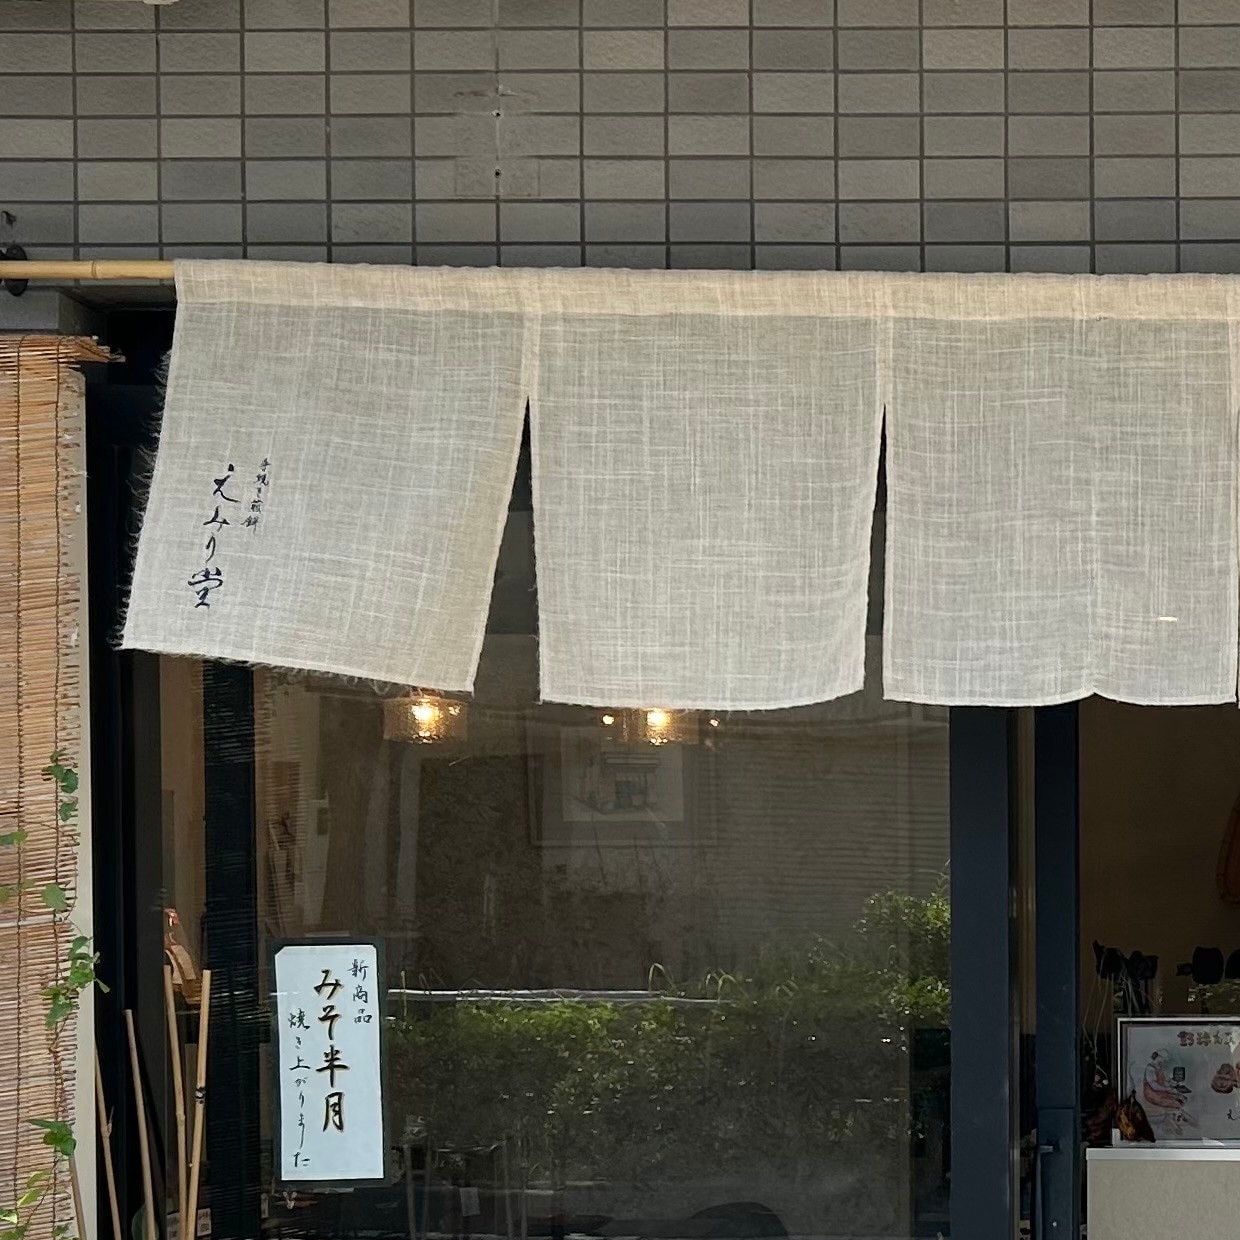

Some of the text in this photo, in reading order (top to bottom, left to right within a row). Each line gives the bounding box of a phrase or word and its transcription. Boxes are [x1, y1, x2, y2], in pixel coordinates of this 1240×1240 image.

[187, 463, 241, 609] えみり堂
[313, 968, 350, 1132] みそ半月
[347, 958, 373, 1024] 新商品
